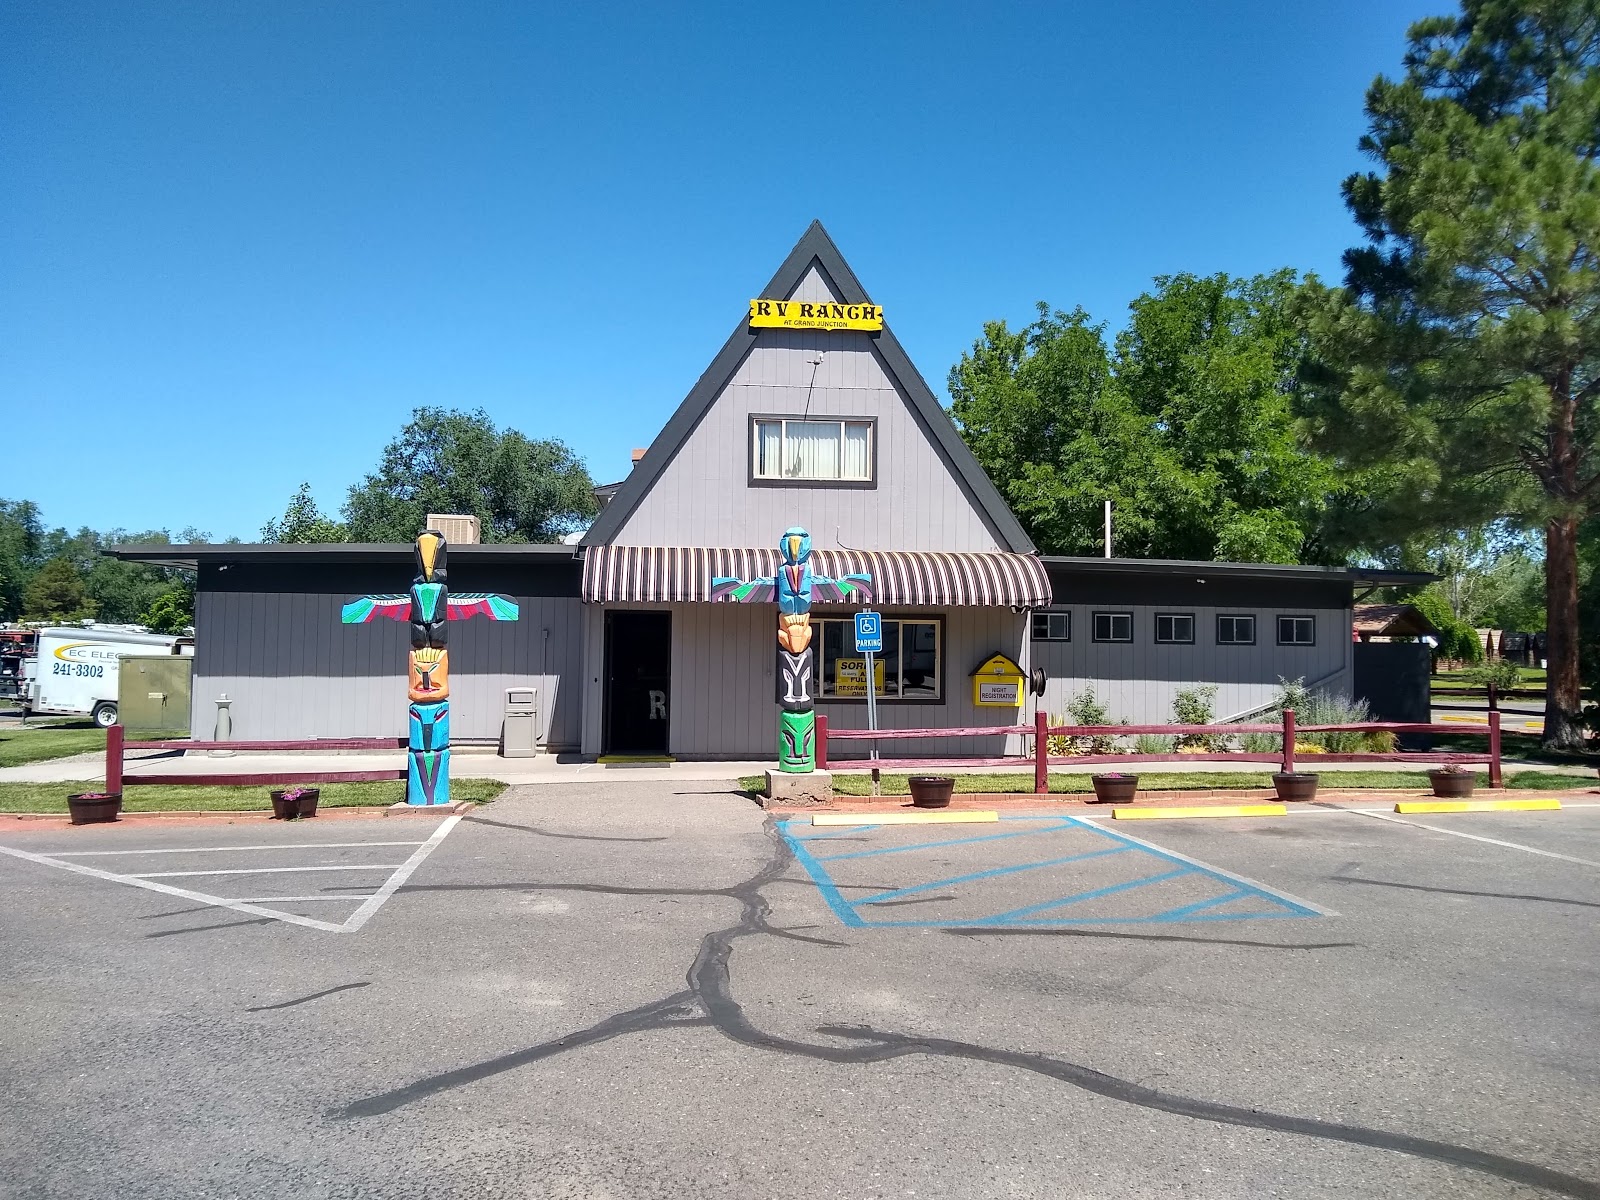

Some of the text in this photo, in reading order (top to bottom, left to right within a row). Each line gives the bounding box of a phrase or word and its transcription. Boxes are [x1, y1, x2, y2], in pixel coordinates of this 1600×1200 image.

[757, 301, 876, 320] RV RANCH
[856, 639, 881, 647] PARKING
[91, 651, 134, 660] ELEC
[52, 662, 104, 678] 241-3302
[841, 661, 879, 670] SORY
